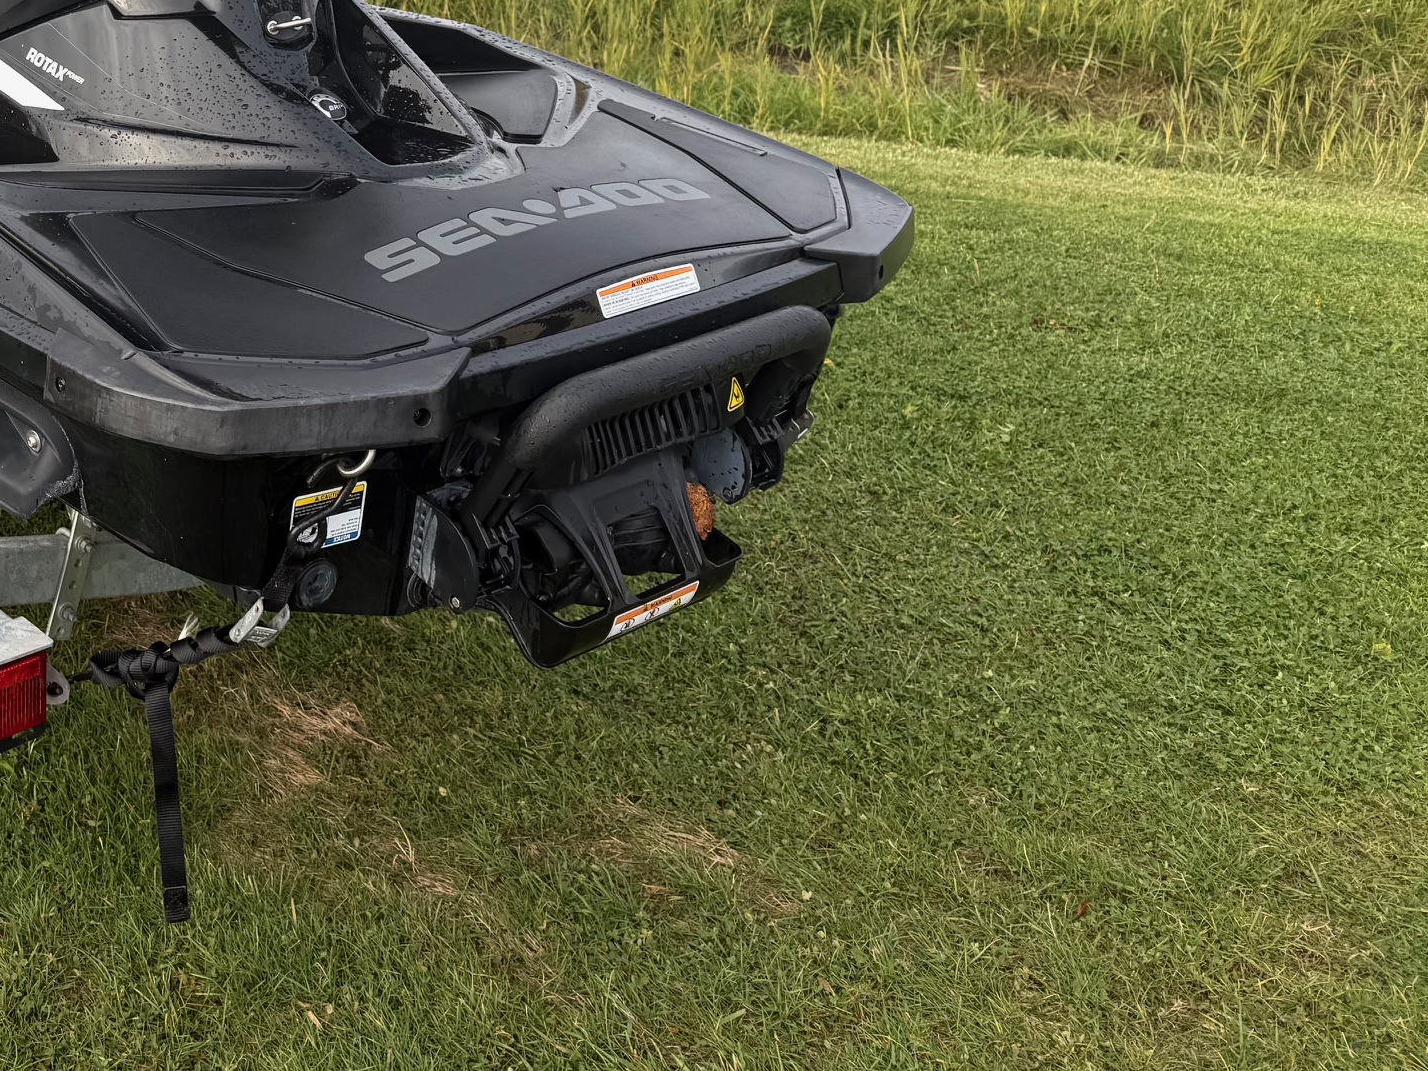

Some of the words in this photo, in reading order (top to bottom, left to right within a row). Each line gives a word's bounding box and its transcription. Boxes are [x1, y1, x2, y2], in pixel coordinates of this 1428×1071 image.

[26, 47, 68, 82] ROTAX
[66, 70, 85, 84] POWER
[636, 274, 659, 286] WARNING
